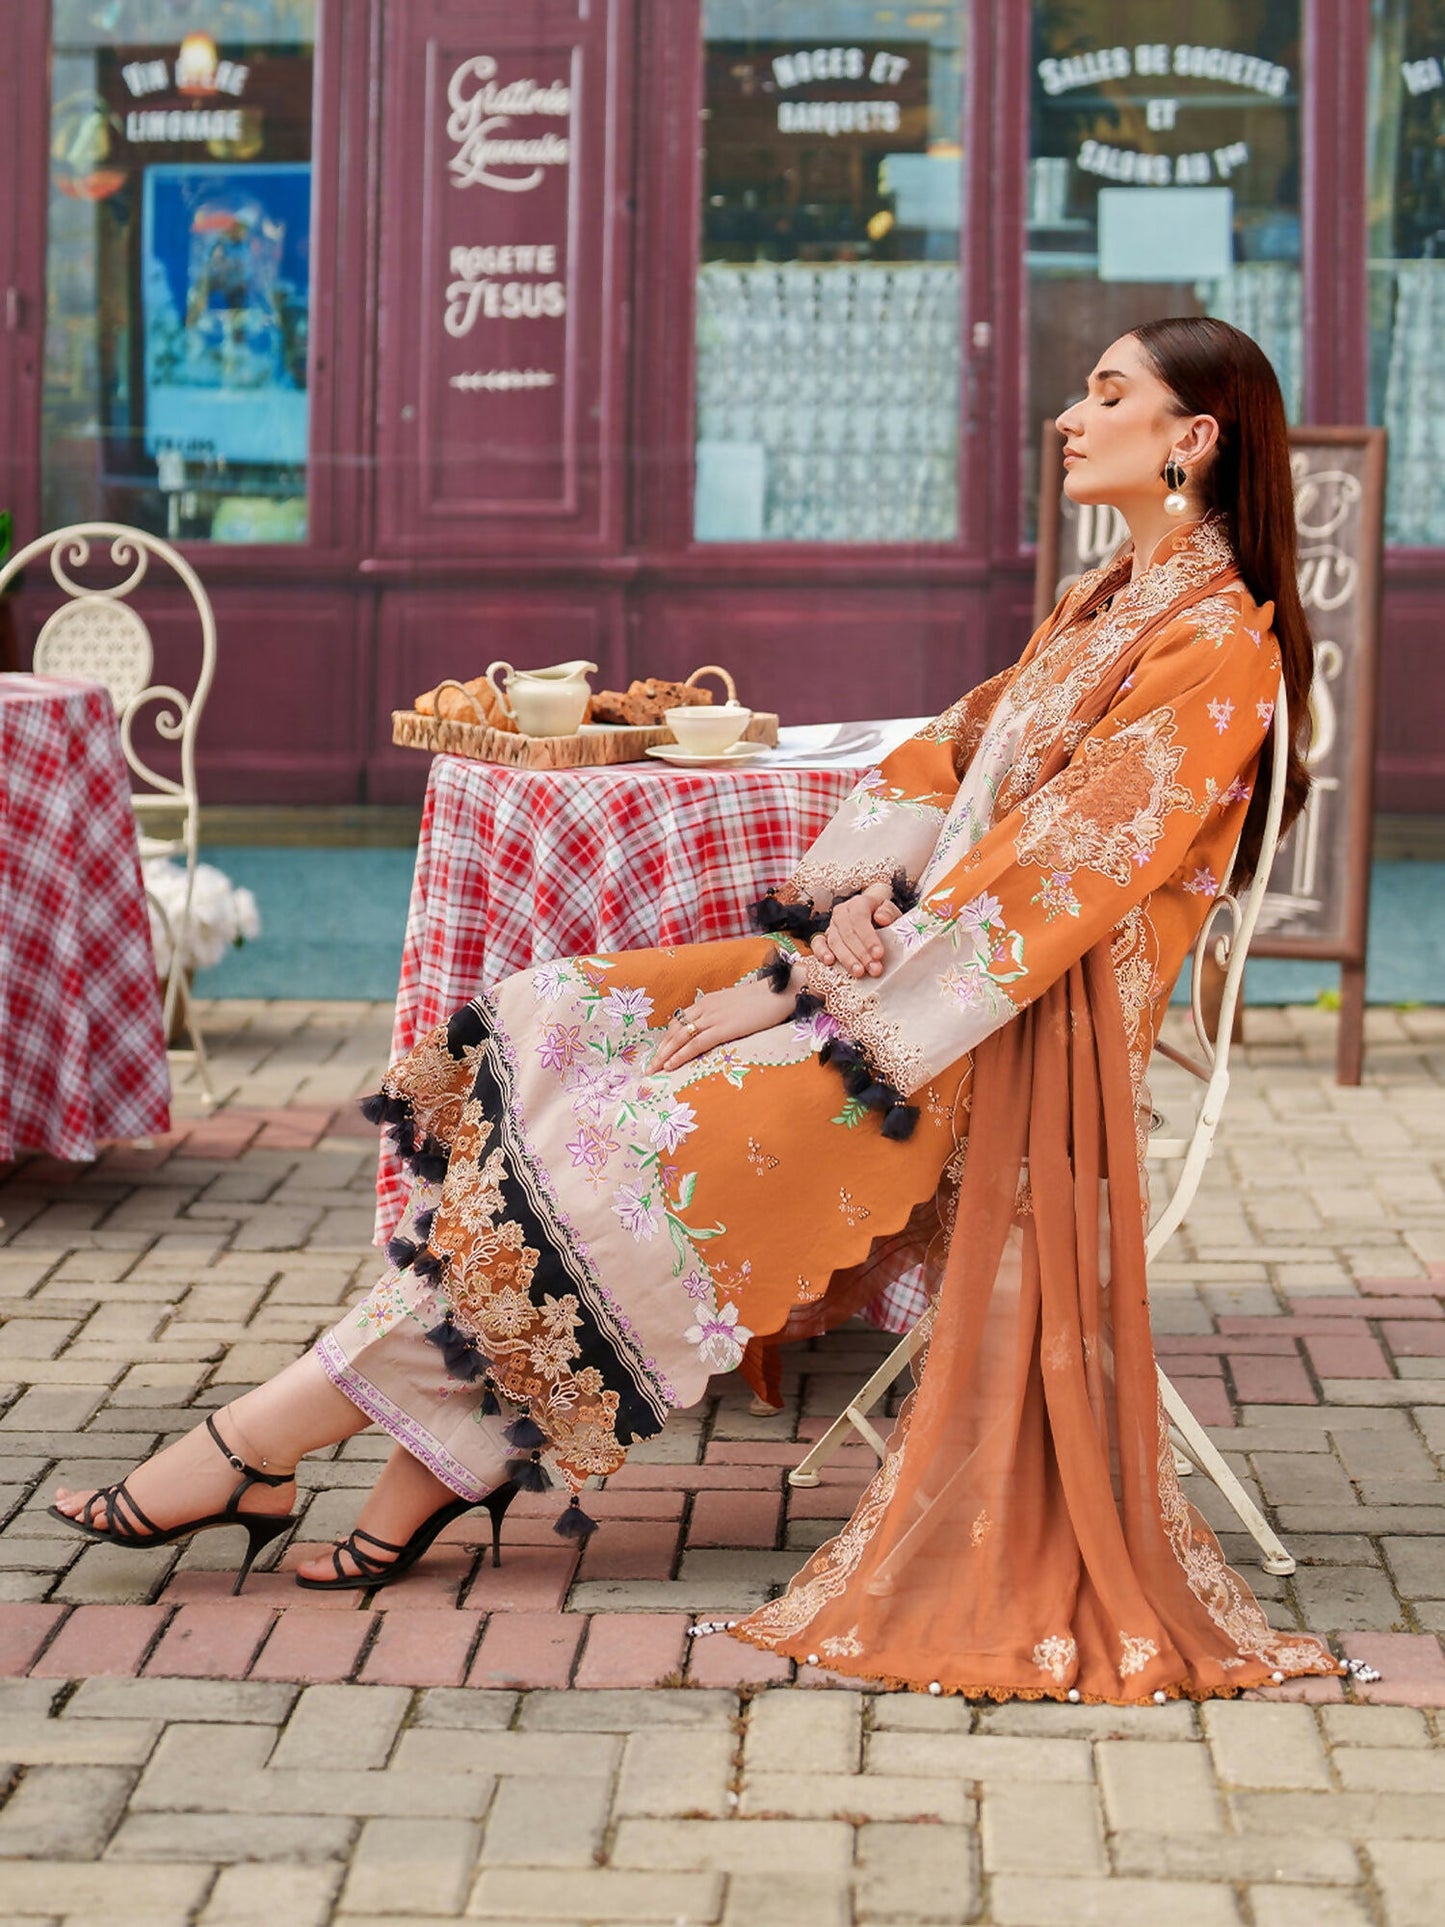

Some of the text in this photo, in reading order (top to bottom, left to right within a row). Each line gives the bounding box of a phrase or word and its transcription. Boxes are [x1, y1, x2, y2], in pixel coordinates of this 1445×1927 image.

[869, 51, 910, 86] ET
[1135, 43, 1171, 76] DE
[777, 101, 901, 137] BANQUETS
[1146, 99, 1180, 131] ET
[449, 244, 557, 280] ROSETTE
[443, 279, 567, 339] JESUS
